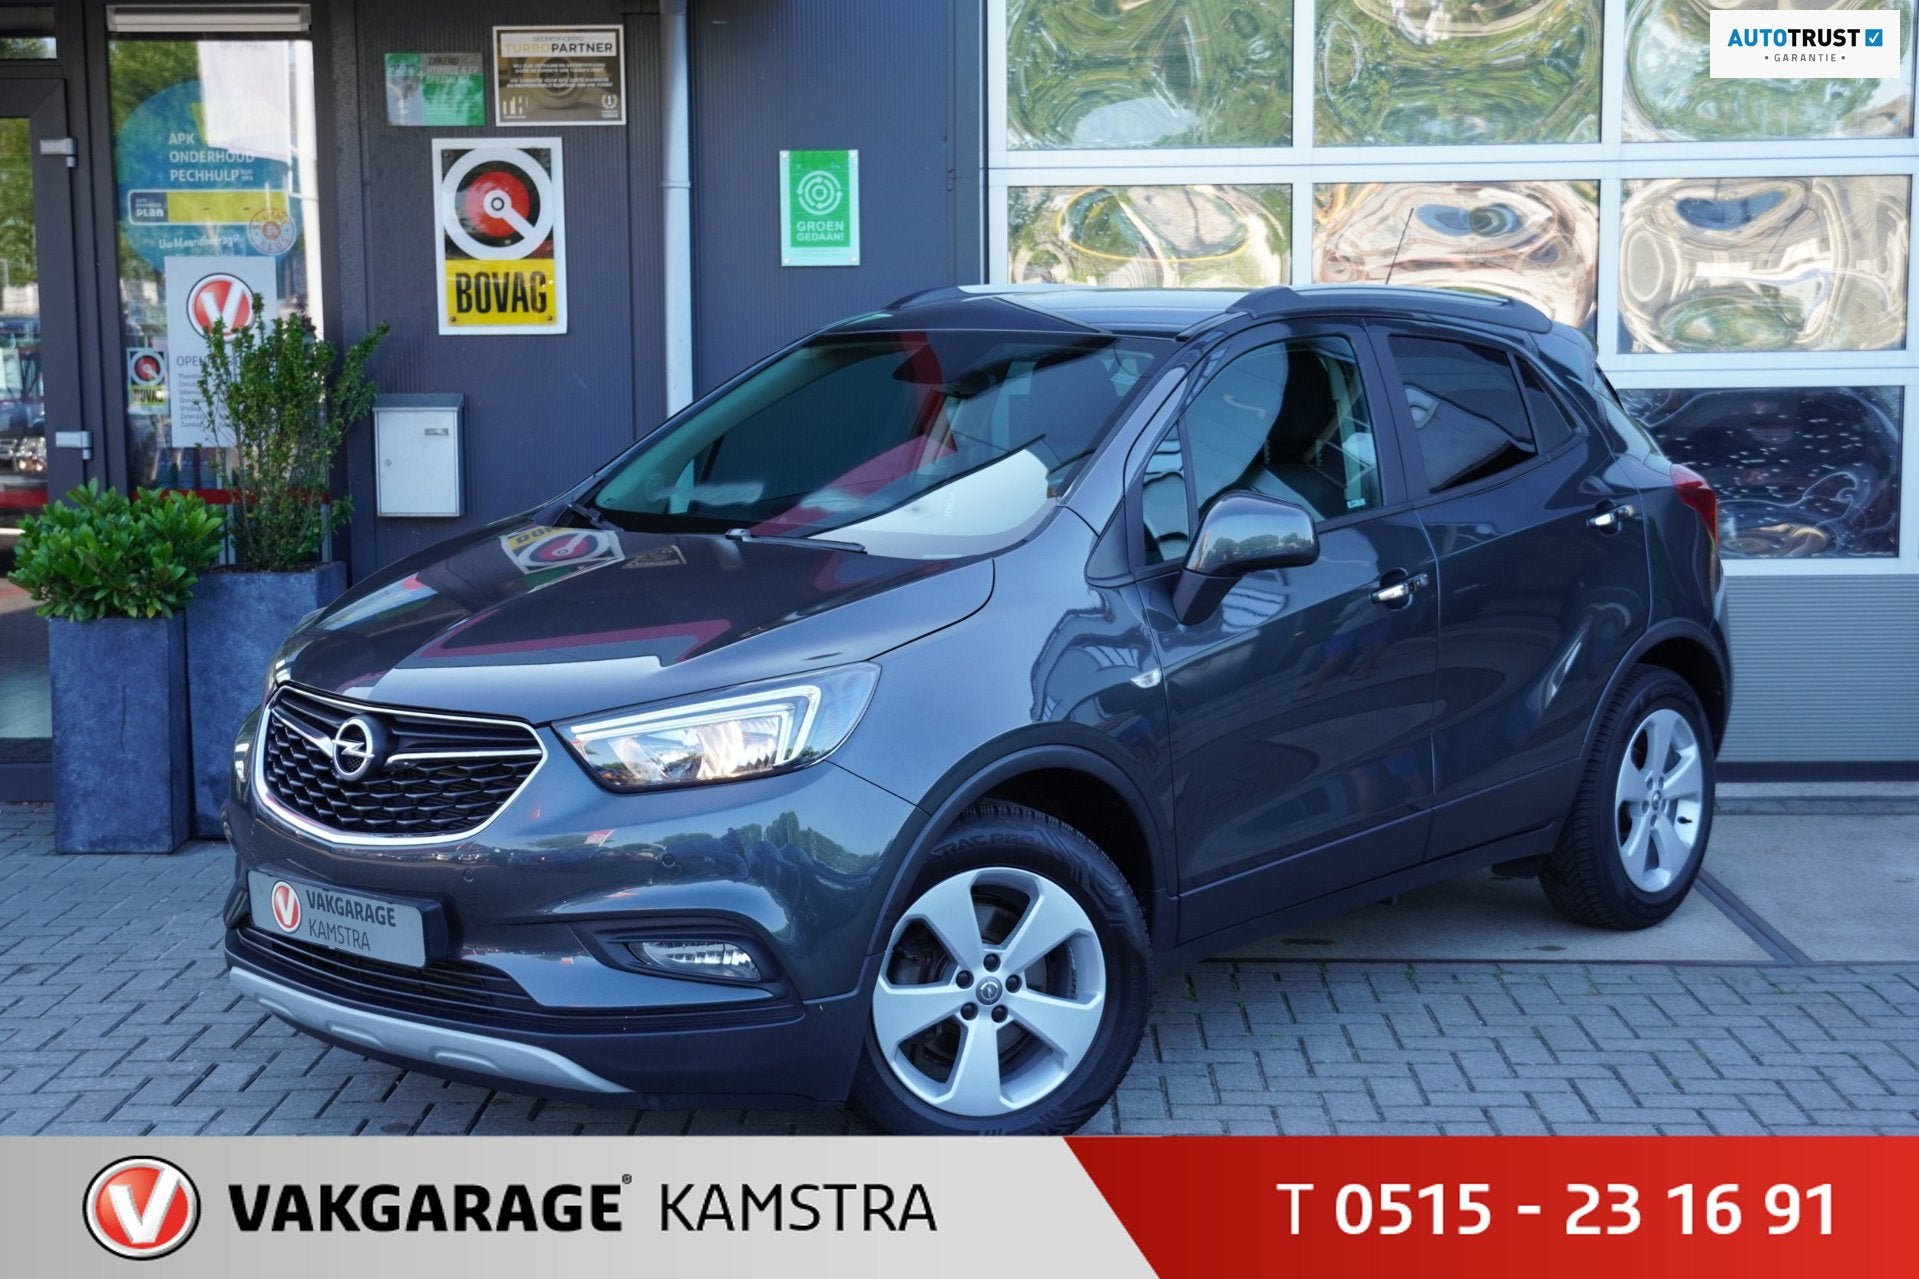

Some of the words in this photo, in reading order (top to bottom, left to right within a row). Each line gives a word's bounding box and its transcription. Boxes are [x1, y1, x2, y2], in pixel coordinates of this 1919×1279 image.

[169, 132, 195, 145] APK
[169, 150, 255, 163] ONDERHOUD
[170, 169, 239, 182] PECHHULP
[796, 221, 844, 231] GROEN
[796, 232, 844, 241] GEDAAN!
[455, 271, 548, 314] BOVAG
[306, 889, 396, 927] VAKGARAGE
[308, 918, 370, 951] KAMSTRA
